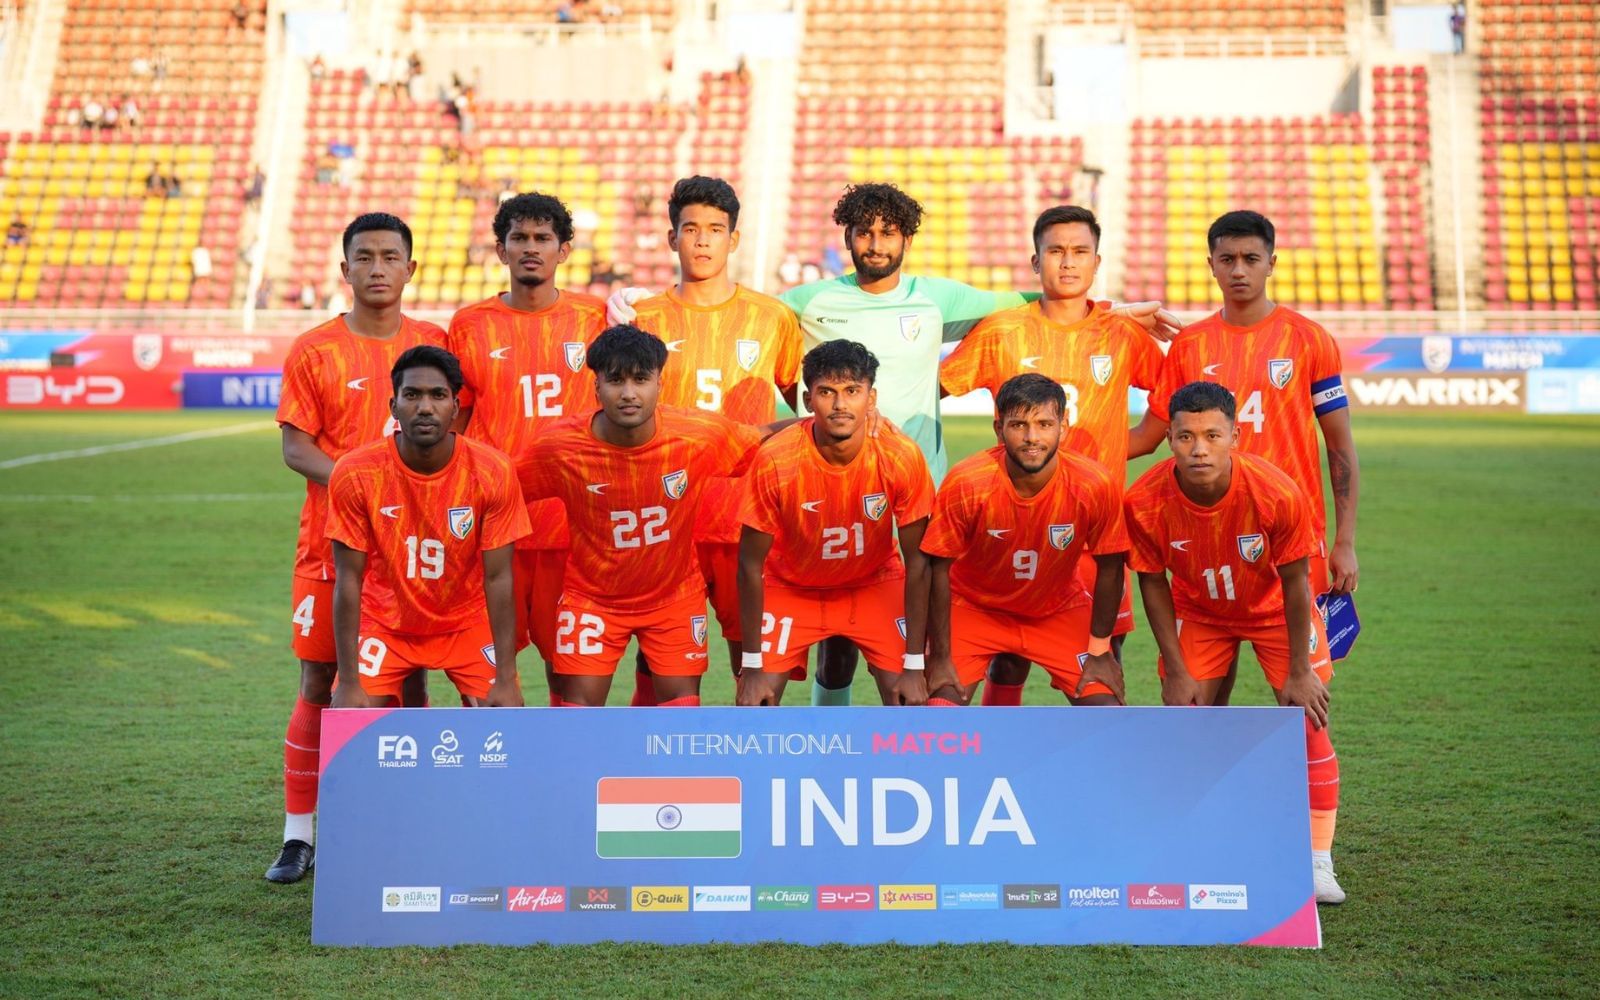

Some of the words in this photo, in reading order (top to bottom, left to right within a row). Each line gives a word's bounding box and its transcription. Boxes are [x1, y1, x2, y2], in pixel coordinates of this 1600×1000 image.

[7, 375, 125, 404] BYD
[519, 373, 563, 417] 12
[696, 369, 722, 411] 5
[1350, 378, 1521, 405] WARRIX
[610, 505, 671, 549] 22
[822, 522, 865, 560] 21
[405, 535, 445, 579] 19
[1013, 549, 1039, 580] 9
[1202, 565, 1236, 600] 11
[292, 595, 316, 637] 4
[556, 611, 605, 655] 22
[761, 612, 794, 655] 21
[358, 636, 387, 678] 9
[378, 735, 417, 760] FA
[480, 753, 508, 763] NSDF
[646, 733, 863, 756] INTERNATIONAL
[871, 732, 982, 755] MATCH
[771, 777, 1037, 847] INDIA
[707, 895, 748, 903] DAIKIN
[774, 890, 810, 904] Chang
[821, 892, 871, 903] BYD
[899, 893, 933, 901] M-150
[1043, 893, 1057, 901] 32
[1069, 887, 1119, 899] molten
